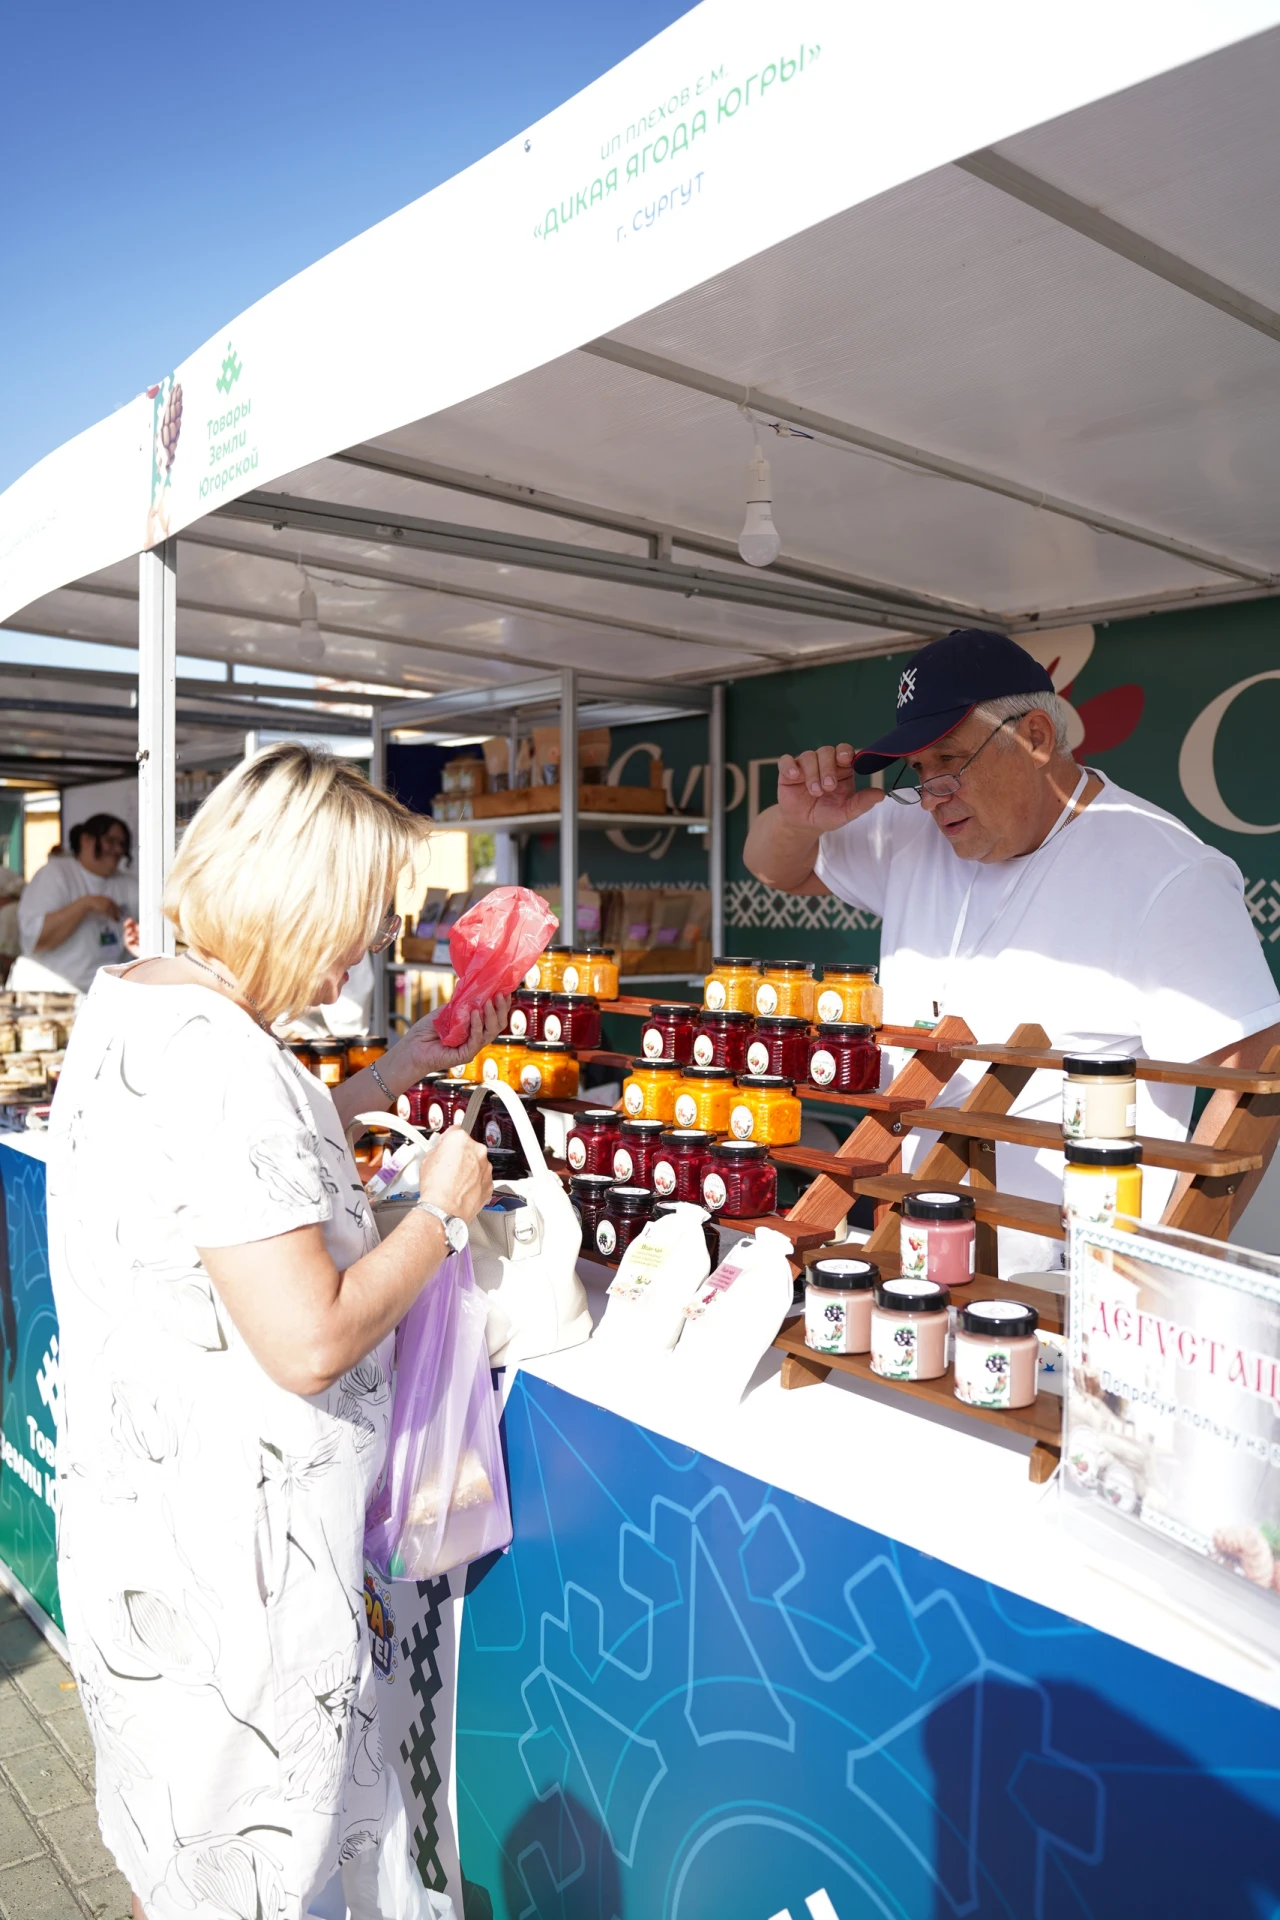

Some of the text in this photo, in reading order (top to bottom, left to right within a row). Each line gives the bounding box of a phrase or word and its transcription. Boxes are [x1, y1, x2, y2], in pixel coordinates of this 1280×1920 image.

[533, 43, 821, 241] «ДИКАЯ ЯГОДА ЮГРЫ»
[625, 86, 690, 145] ПЛЕХОВ
[616, 171, 705, 243] г. СУРГУТ
[207, 398, 251, 440] Товары
[199, 447, 259, 500] Югорской
[209, 429, 247, 466] Земли
